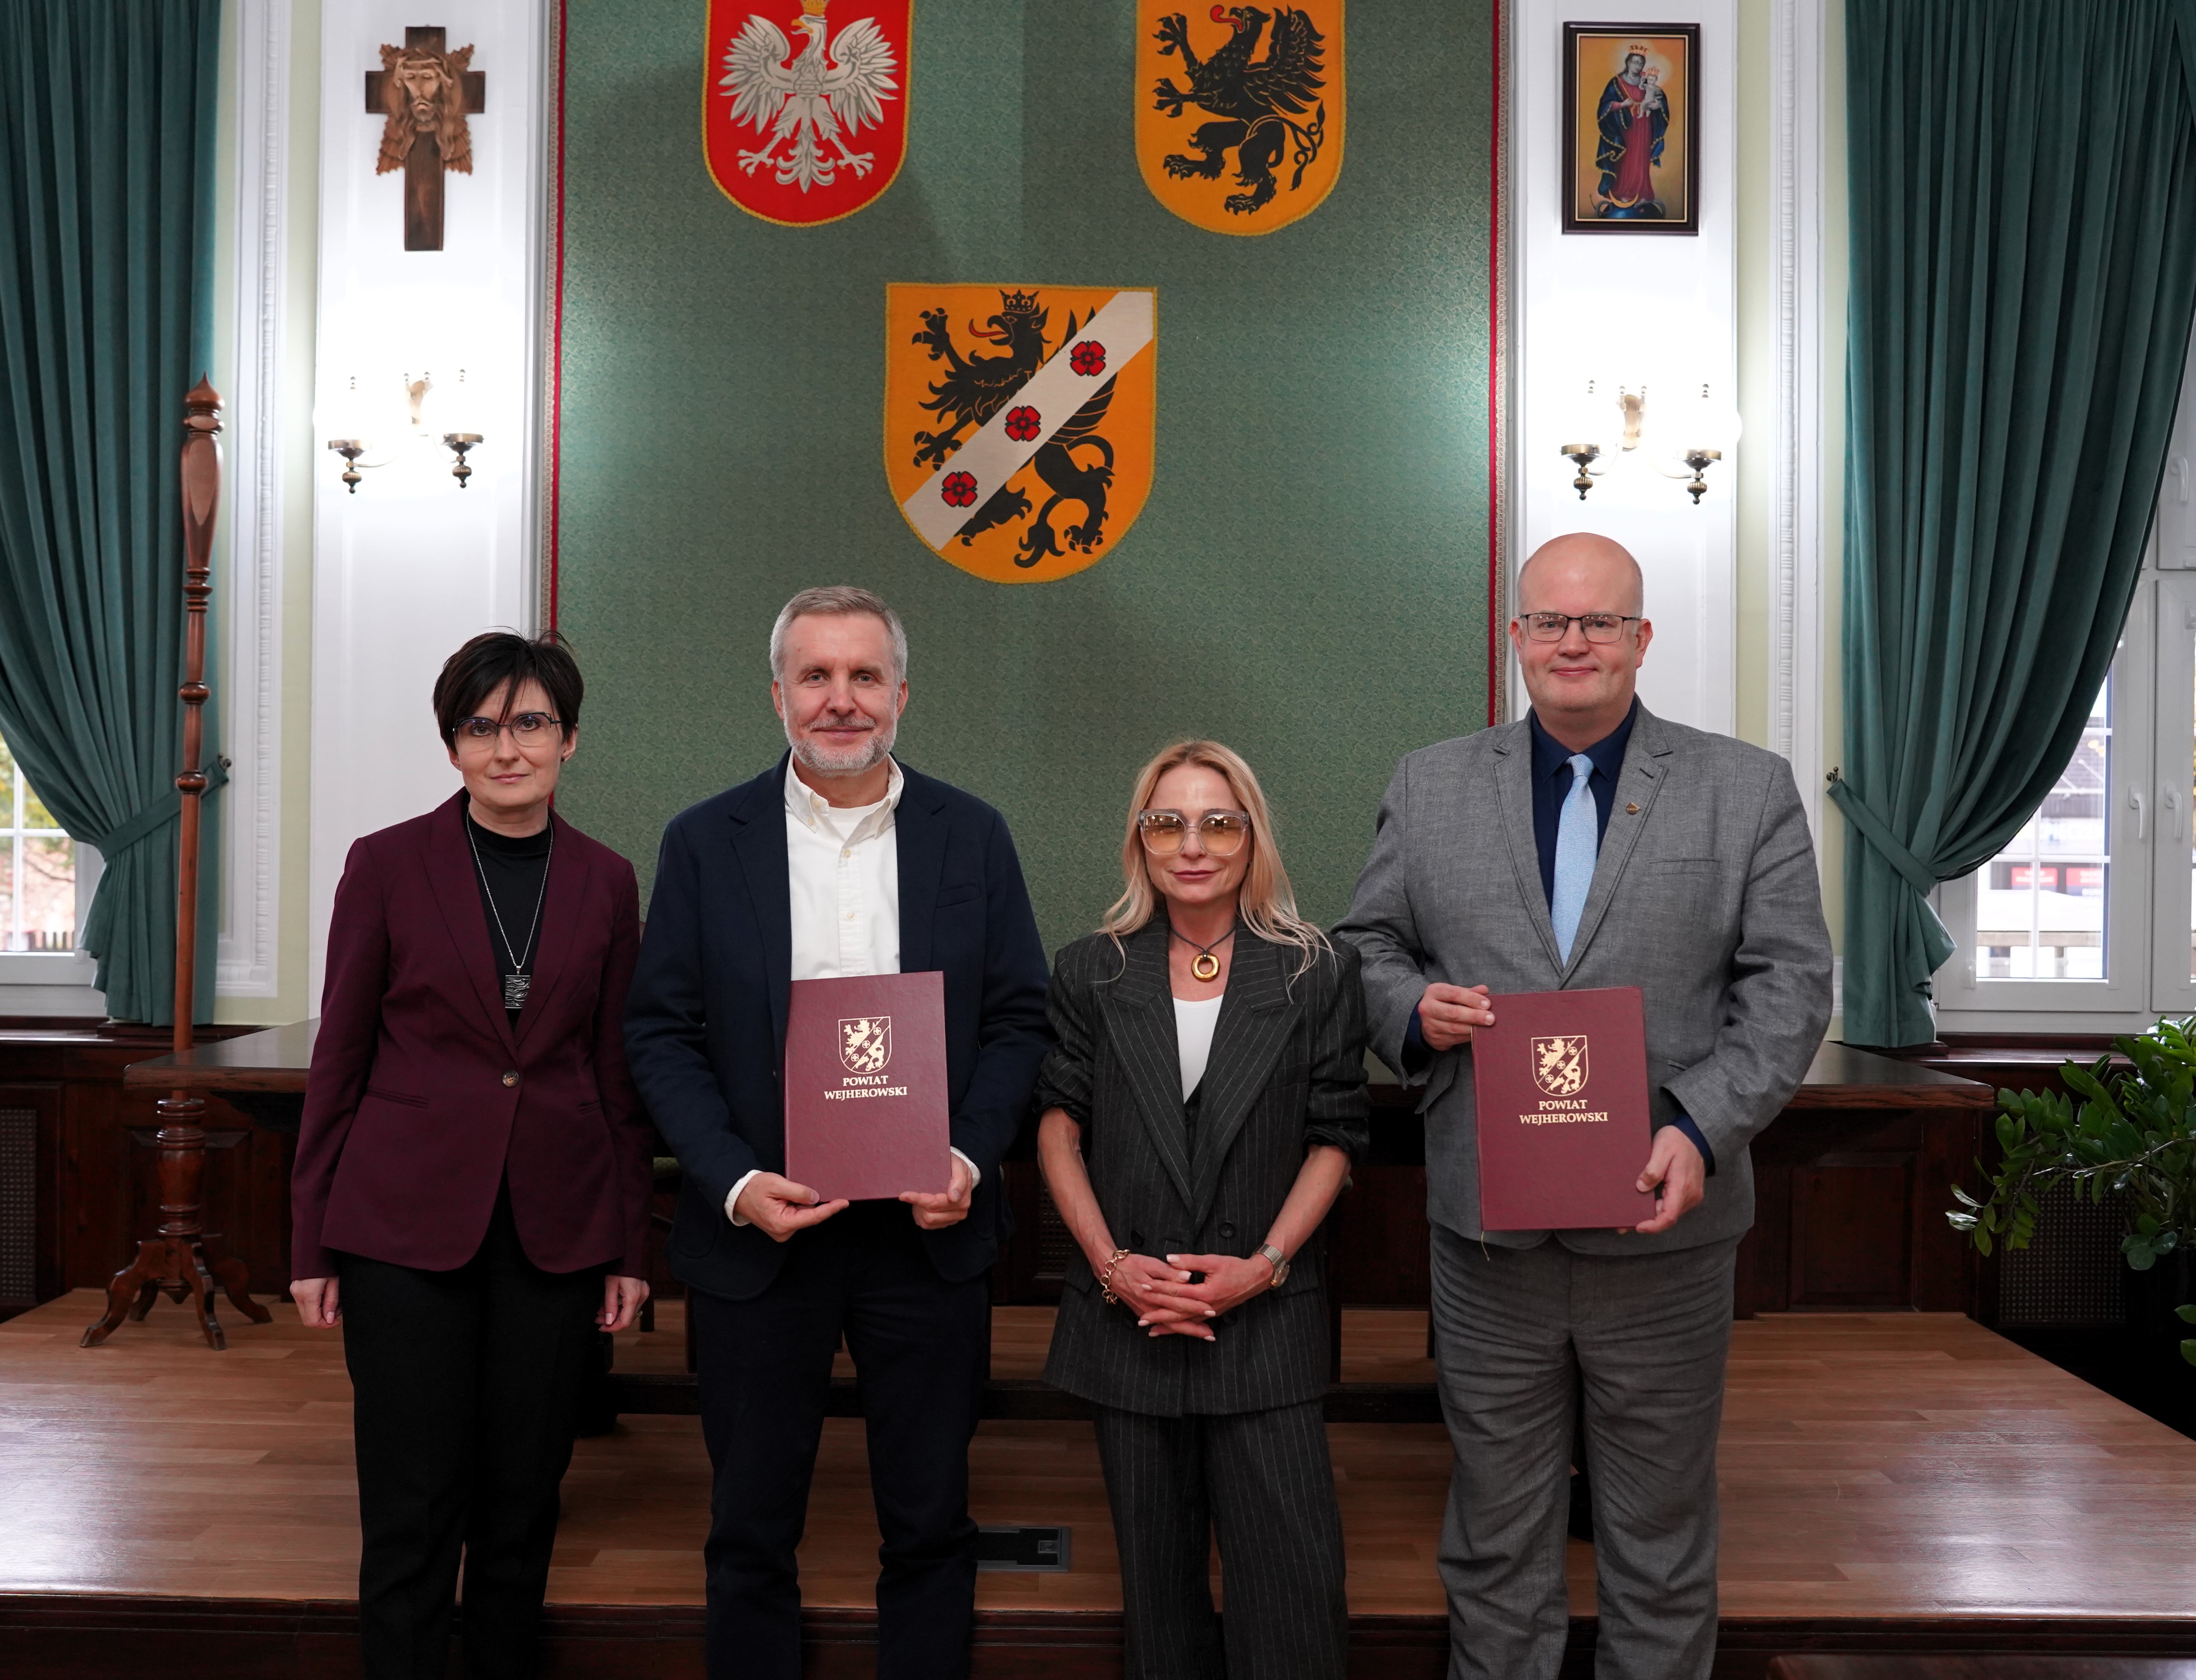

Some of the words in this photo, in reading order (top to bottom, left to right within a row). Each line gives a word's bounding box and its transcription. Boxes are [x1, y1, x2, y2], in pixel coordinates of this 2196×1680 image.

[843, 1075, 889, 1086] POWIAT
[824, 1086, 907, 1101] WEJHEROWSKI
[1538, 1100, 1588, 1110] POWIAT
[1519, 1112, 1608, 1126] WEJHEROWSKI
